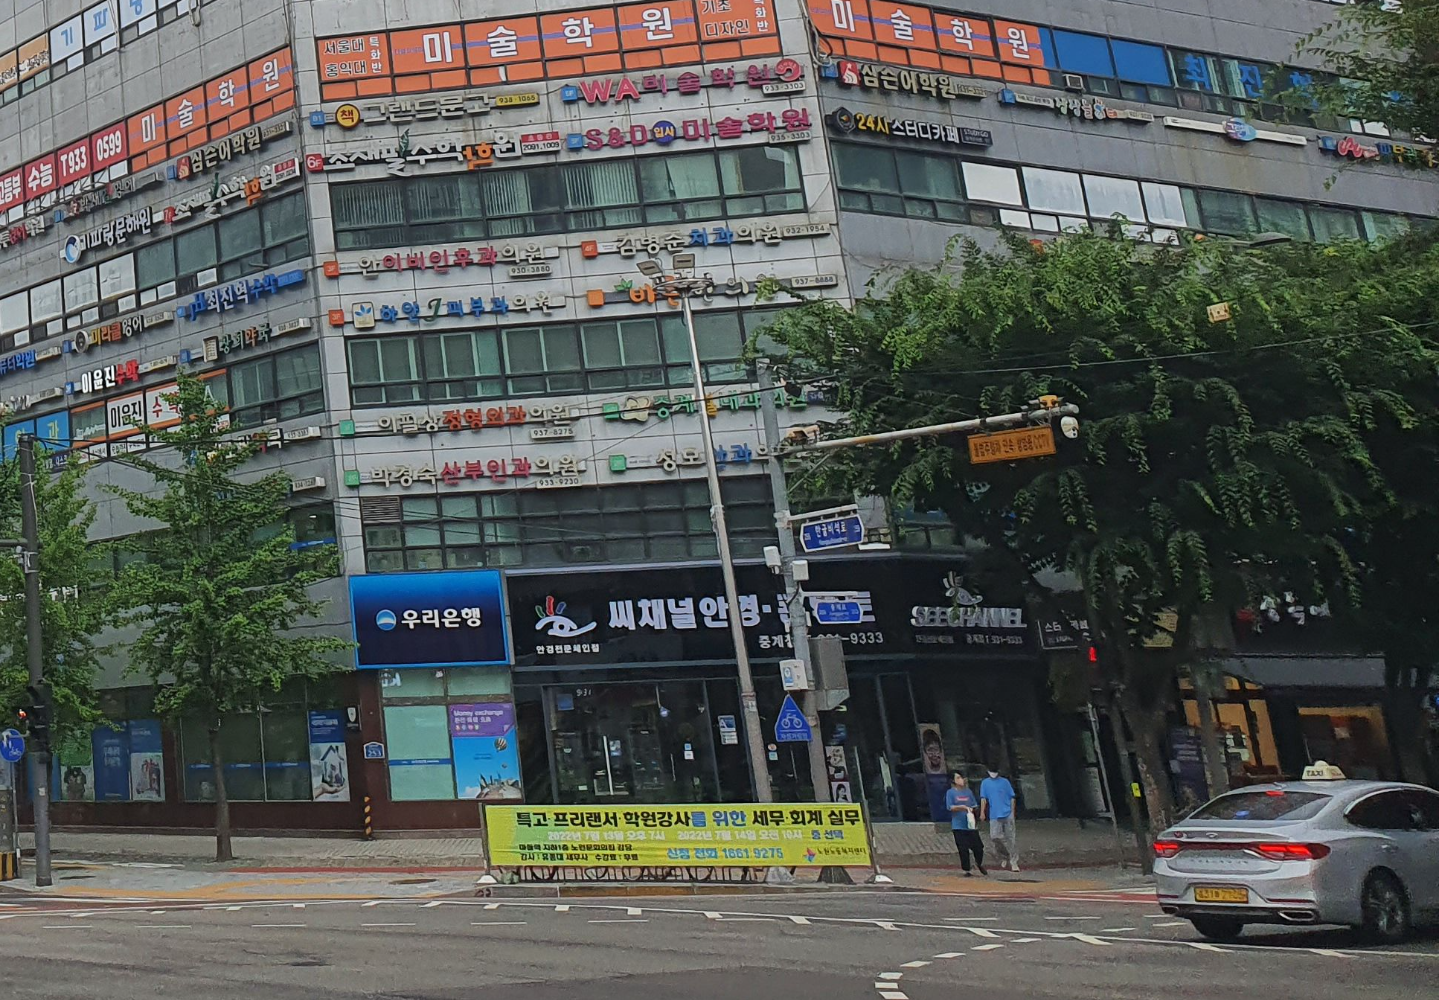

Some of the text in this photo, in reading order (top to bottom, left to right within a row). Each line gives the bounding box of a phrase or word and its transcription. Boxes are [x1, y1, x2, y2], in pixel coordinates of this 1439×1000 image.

[421, 5, 673, 65] 미술학원
[704, 18, 749, 38] 디자인
[324, 38, 365, 54] 서울대
[325, 60, 367, 77] 홍익대
[861, 64, 957, 99] 심슨어학원
[764, 81, 804, 92] 933-3303
[140, 58, 280, 144] 미술학원
[340, 91, 492, 124] 책 그랜드문고
[586, 107, 812, 150] S&D 미술학원 935-3303
[855, 112, 960, 144] 24시 스터디카페
[96, 130, 122, 162] 0599
[191, 126, 262, 173] 심슨어학원
[27, 160, 53, 192] 수능
[306, 157, 323, 169] 6F
[617, 222, 783, 257] 김병준치과의원
[785, 225, 825, 235] 932-1954
[358, 242, 552, 280] 안이비인후과의원 930-3880
[794, 276, 834, 286] 937-8888
[90, 315, 143, 345] 미라클영어
[81, 359, 140, 394] 이윤진수학
[378, 403, 572, 434] 이필상정형외과의원
[370, 453, 580, 489] 박경숙산부인과의원 933-9230
[401, 607, 482, 629] 우리은행
[535, 643, 600, 655] 안경전문체인점
[1305, 769, 1324, 777] TAXI
[712, 810, 747, 827] 위한
[751, 809, 824, 827] 세무·회계
[827, 809, 861, 826] 실무
[543, 843, 570, 852] 지하1층
[571, 843, 615, 852] 노원문화의집
[548, 831, 582, 841] 2022년
[583, 831, 600, 841] 7월
[627, 831, 646, 841] 오후
[648, 830, 666, 841] 7시
[677, 830, 712, 841] 2022년
[715, 830, 732, 841] 7월
[735, 829, 757, 841] 14일
[759, 829, 780, 840] 오전
[783, 829, 804, 840] 10시
[824, 829, 845, 840] 선택
[566, 853, 589, 862] 세무사
[623, 853, 639, 862] 무료
[667, 847, 784, 860] 신청 전화 1661 9275
